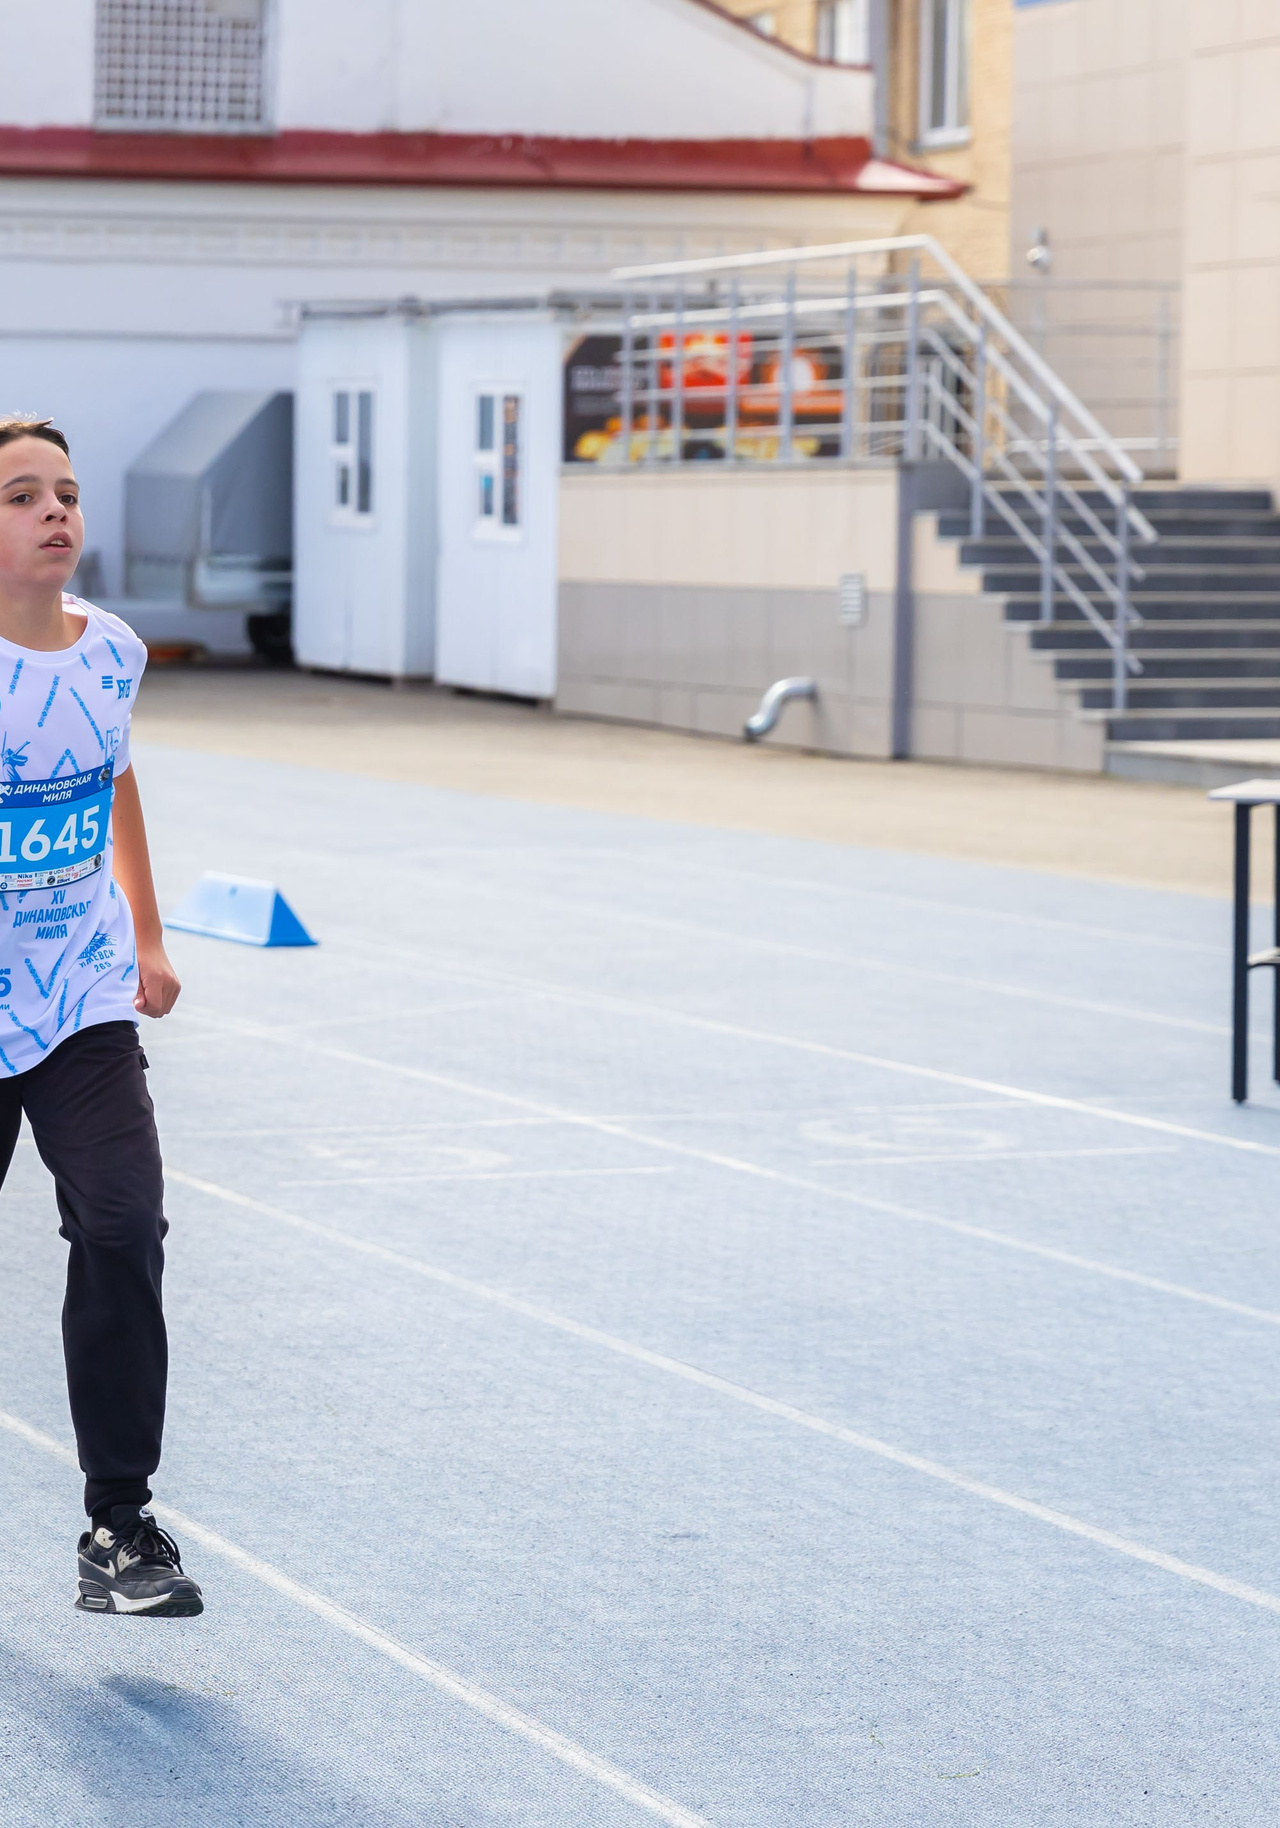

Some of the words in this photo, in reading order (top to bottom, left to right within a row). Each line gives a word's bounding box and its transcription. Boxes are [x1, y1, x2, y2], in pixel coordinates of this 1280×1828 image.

[14, 773, 93, 795] ДИНАМОВСКАЯ
[42, 790, 72, 803] МИЛЯ
[51, 890, 66, 905] XV
[35, 924, 68, 940] МИЛЯ
